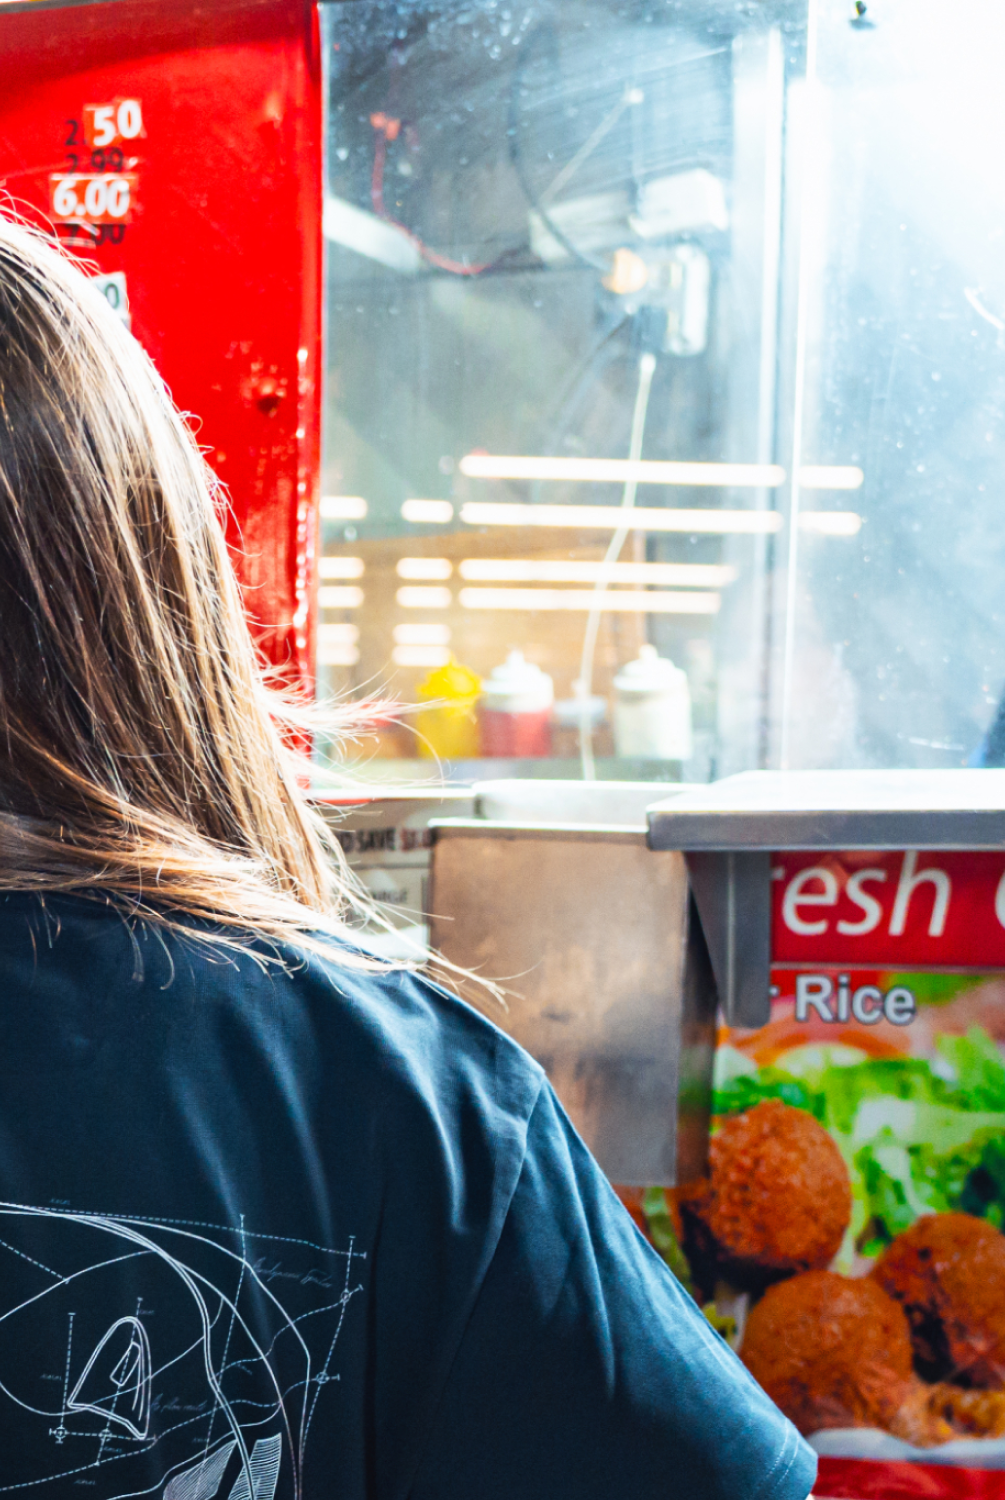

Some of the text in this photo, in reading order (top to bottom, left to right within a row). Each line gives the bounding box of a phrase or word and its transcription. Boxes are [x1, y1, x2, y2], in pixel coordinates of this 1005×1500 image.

[53, 179, 130, 218] 6.00
[772, 850, 952, 937] esh
[795, 974, 916, 1026] Rice
